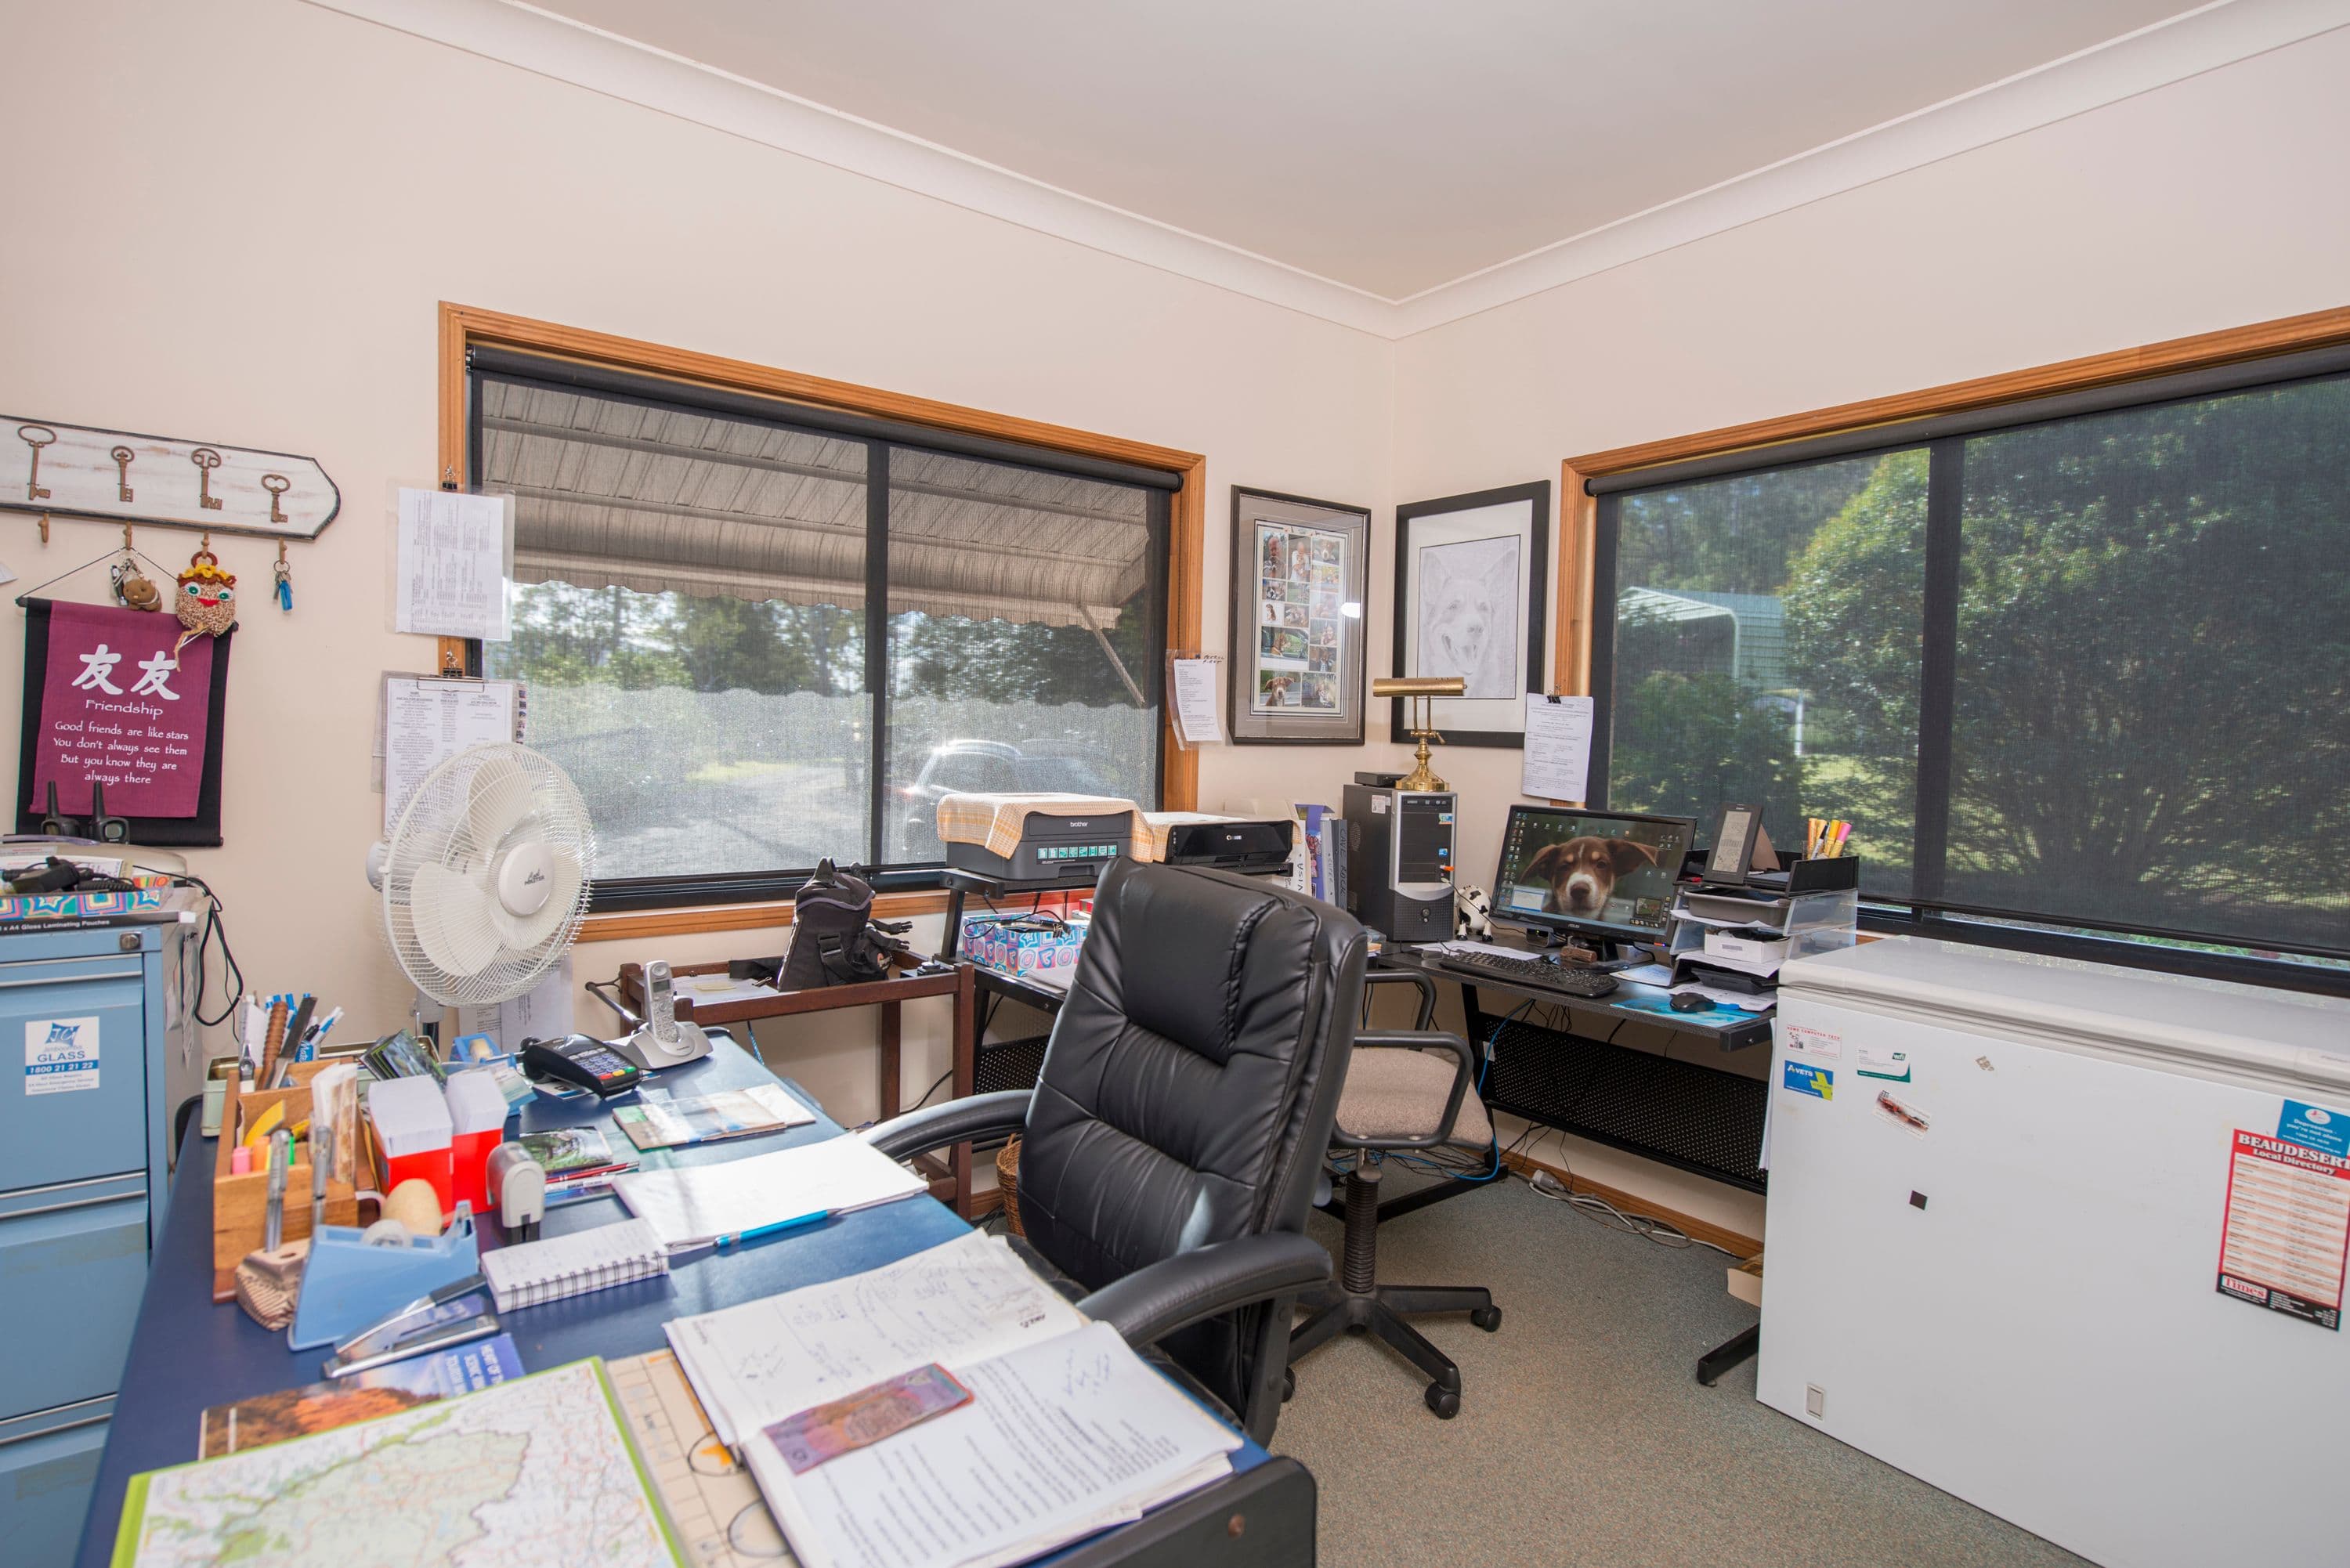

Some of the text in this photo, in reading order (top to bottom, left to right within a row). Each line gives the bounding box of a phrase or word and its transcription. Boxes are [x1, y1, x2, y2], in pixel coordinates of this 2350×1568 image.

[71, 644, 180, 700] 友友
[85, 699, 163, 721] Friendship
[55, 721, 83, 732] Good
[89, 721, 122, 735] friends
[147, 726, 164, 739] like
[165, 731, 189, 740] stars
[53, 737, 71, 747] You
[76, 737, 103, 750] don't
[107, 740, 139, 755] always
[165, 743, 187, 756] them
[60, 753, 79, 764] But
[83, 757, 103, 768] you
[106, 754, 131, 767] know
[136, 757, 157, 772] they
[85, 769, 151, 786] always there
[43, 920, 80, 930] Laminating
[37, 1050, 85, 1063] GLASS
[30, 1065, 52, 1074] 1800
[2253, 1148, 2335, 1176] Local Directory
[2224, 1277, 2265, 1297] Times
